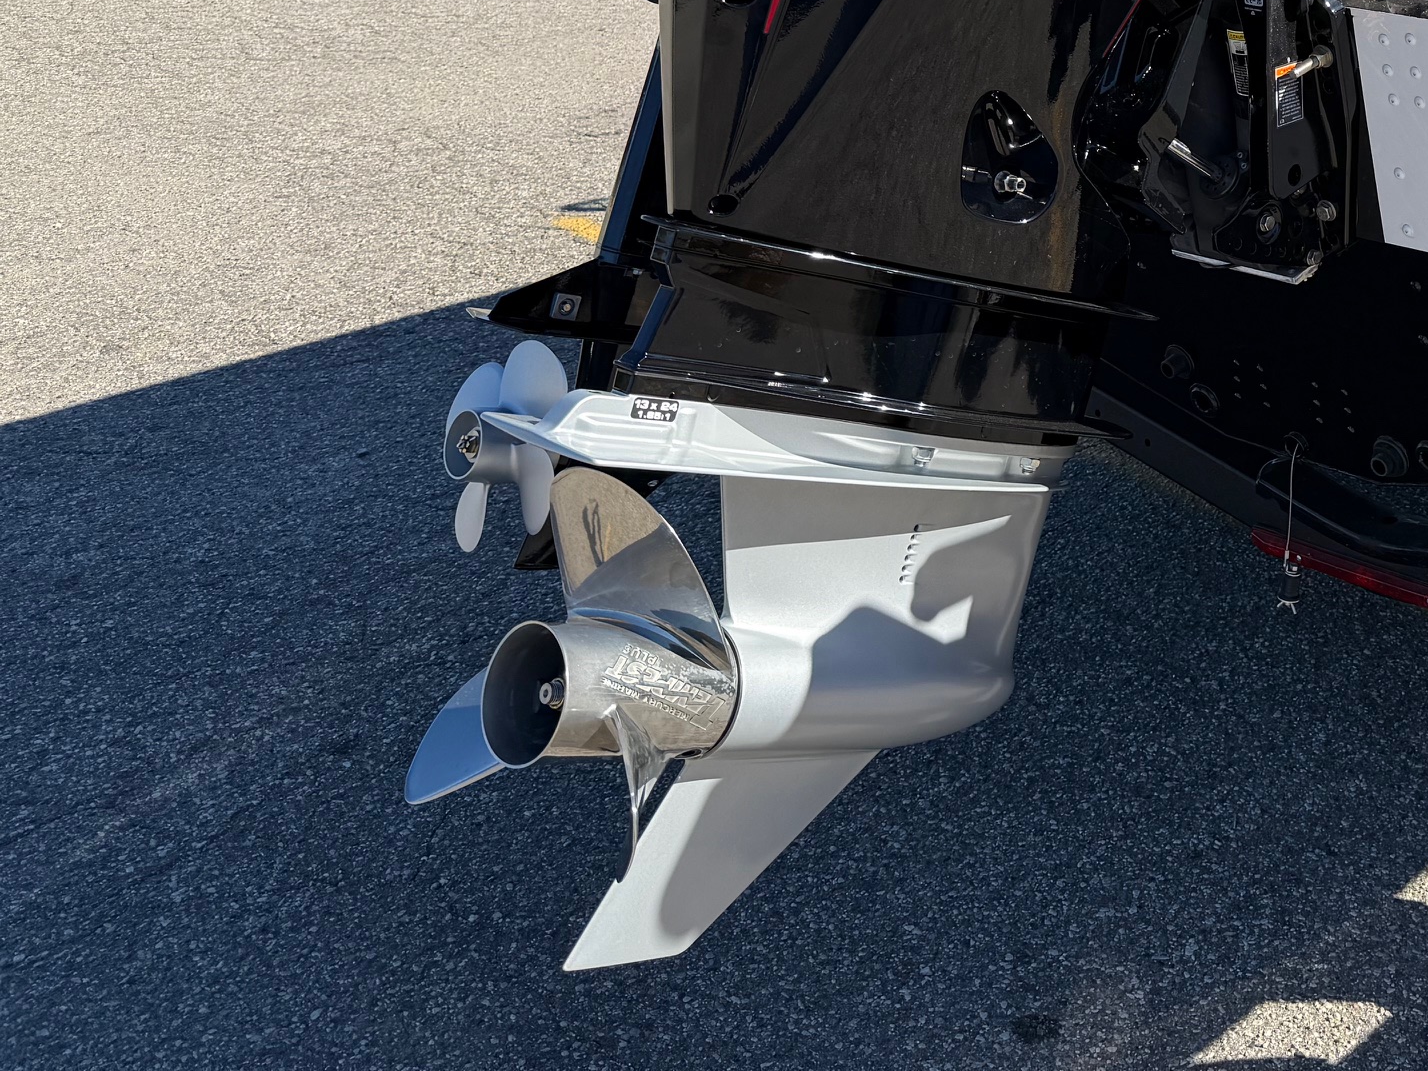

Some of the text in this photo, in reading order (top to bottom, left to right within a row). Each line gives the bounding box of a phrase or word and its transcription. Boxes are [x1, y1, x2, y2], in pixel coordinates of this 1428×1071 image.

[634, 399, 650, 409] 13
[621, 643, 659, 665] PLUS
[642, 696, 691, 723] MERCURY
